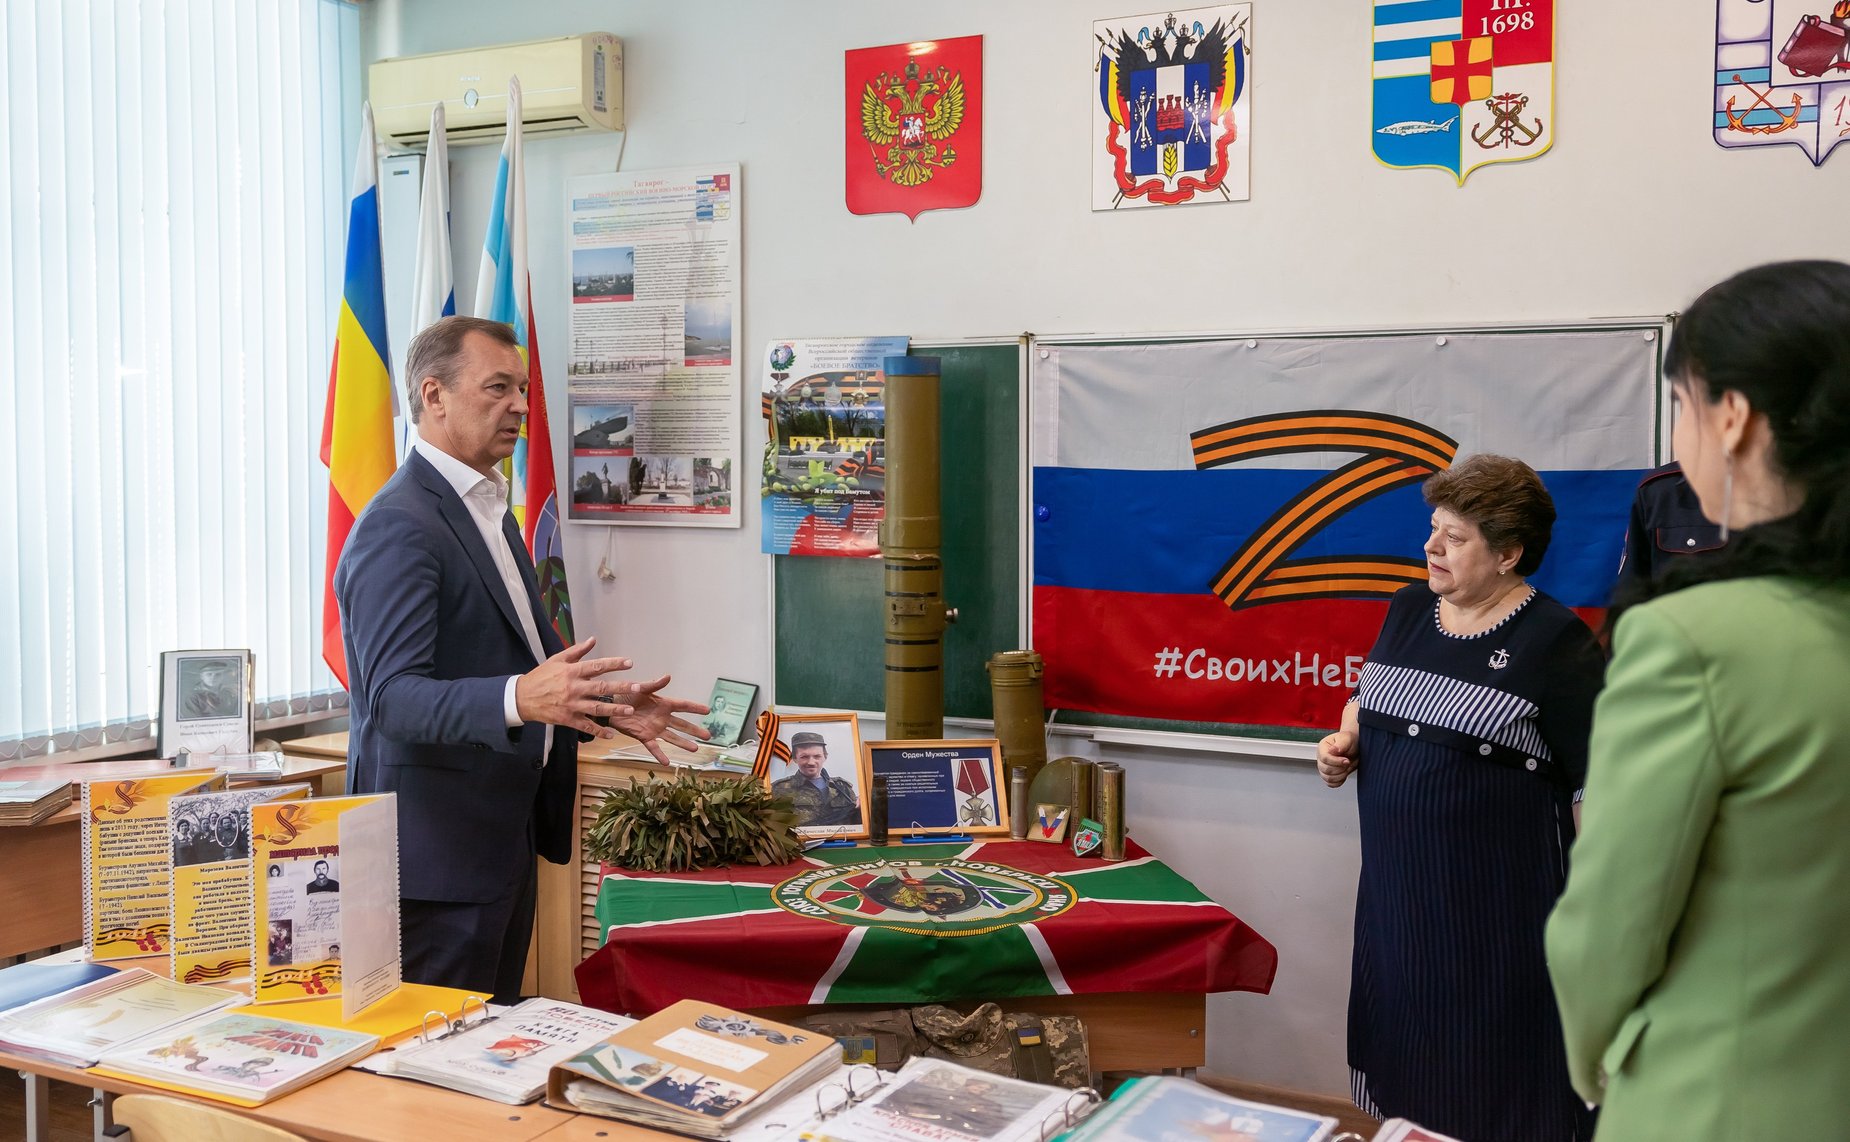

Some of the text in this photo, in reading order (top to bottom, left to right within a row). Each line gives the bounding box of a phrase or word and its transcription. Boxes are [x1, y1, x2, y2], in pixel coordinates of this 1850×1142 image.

[1481, 11, 1534, 35] 1698
[1834, 95, 1850, 127] 1
[1154, 647, 1364, 688] #СвоихНеБ
[514, 1024, 578, 1043] ПАМЯТИ
